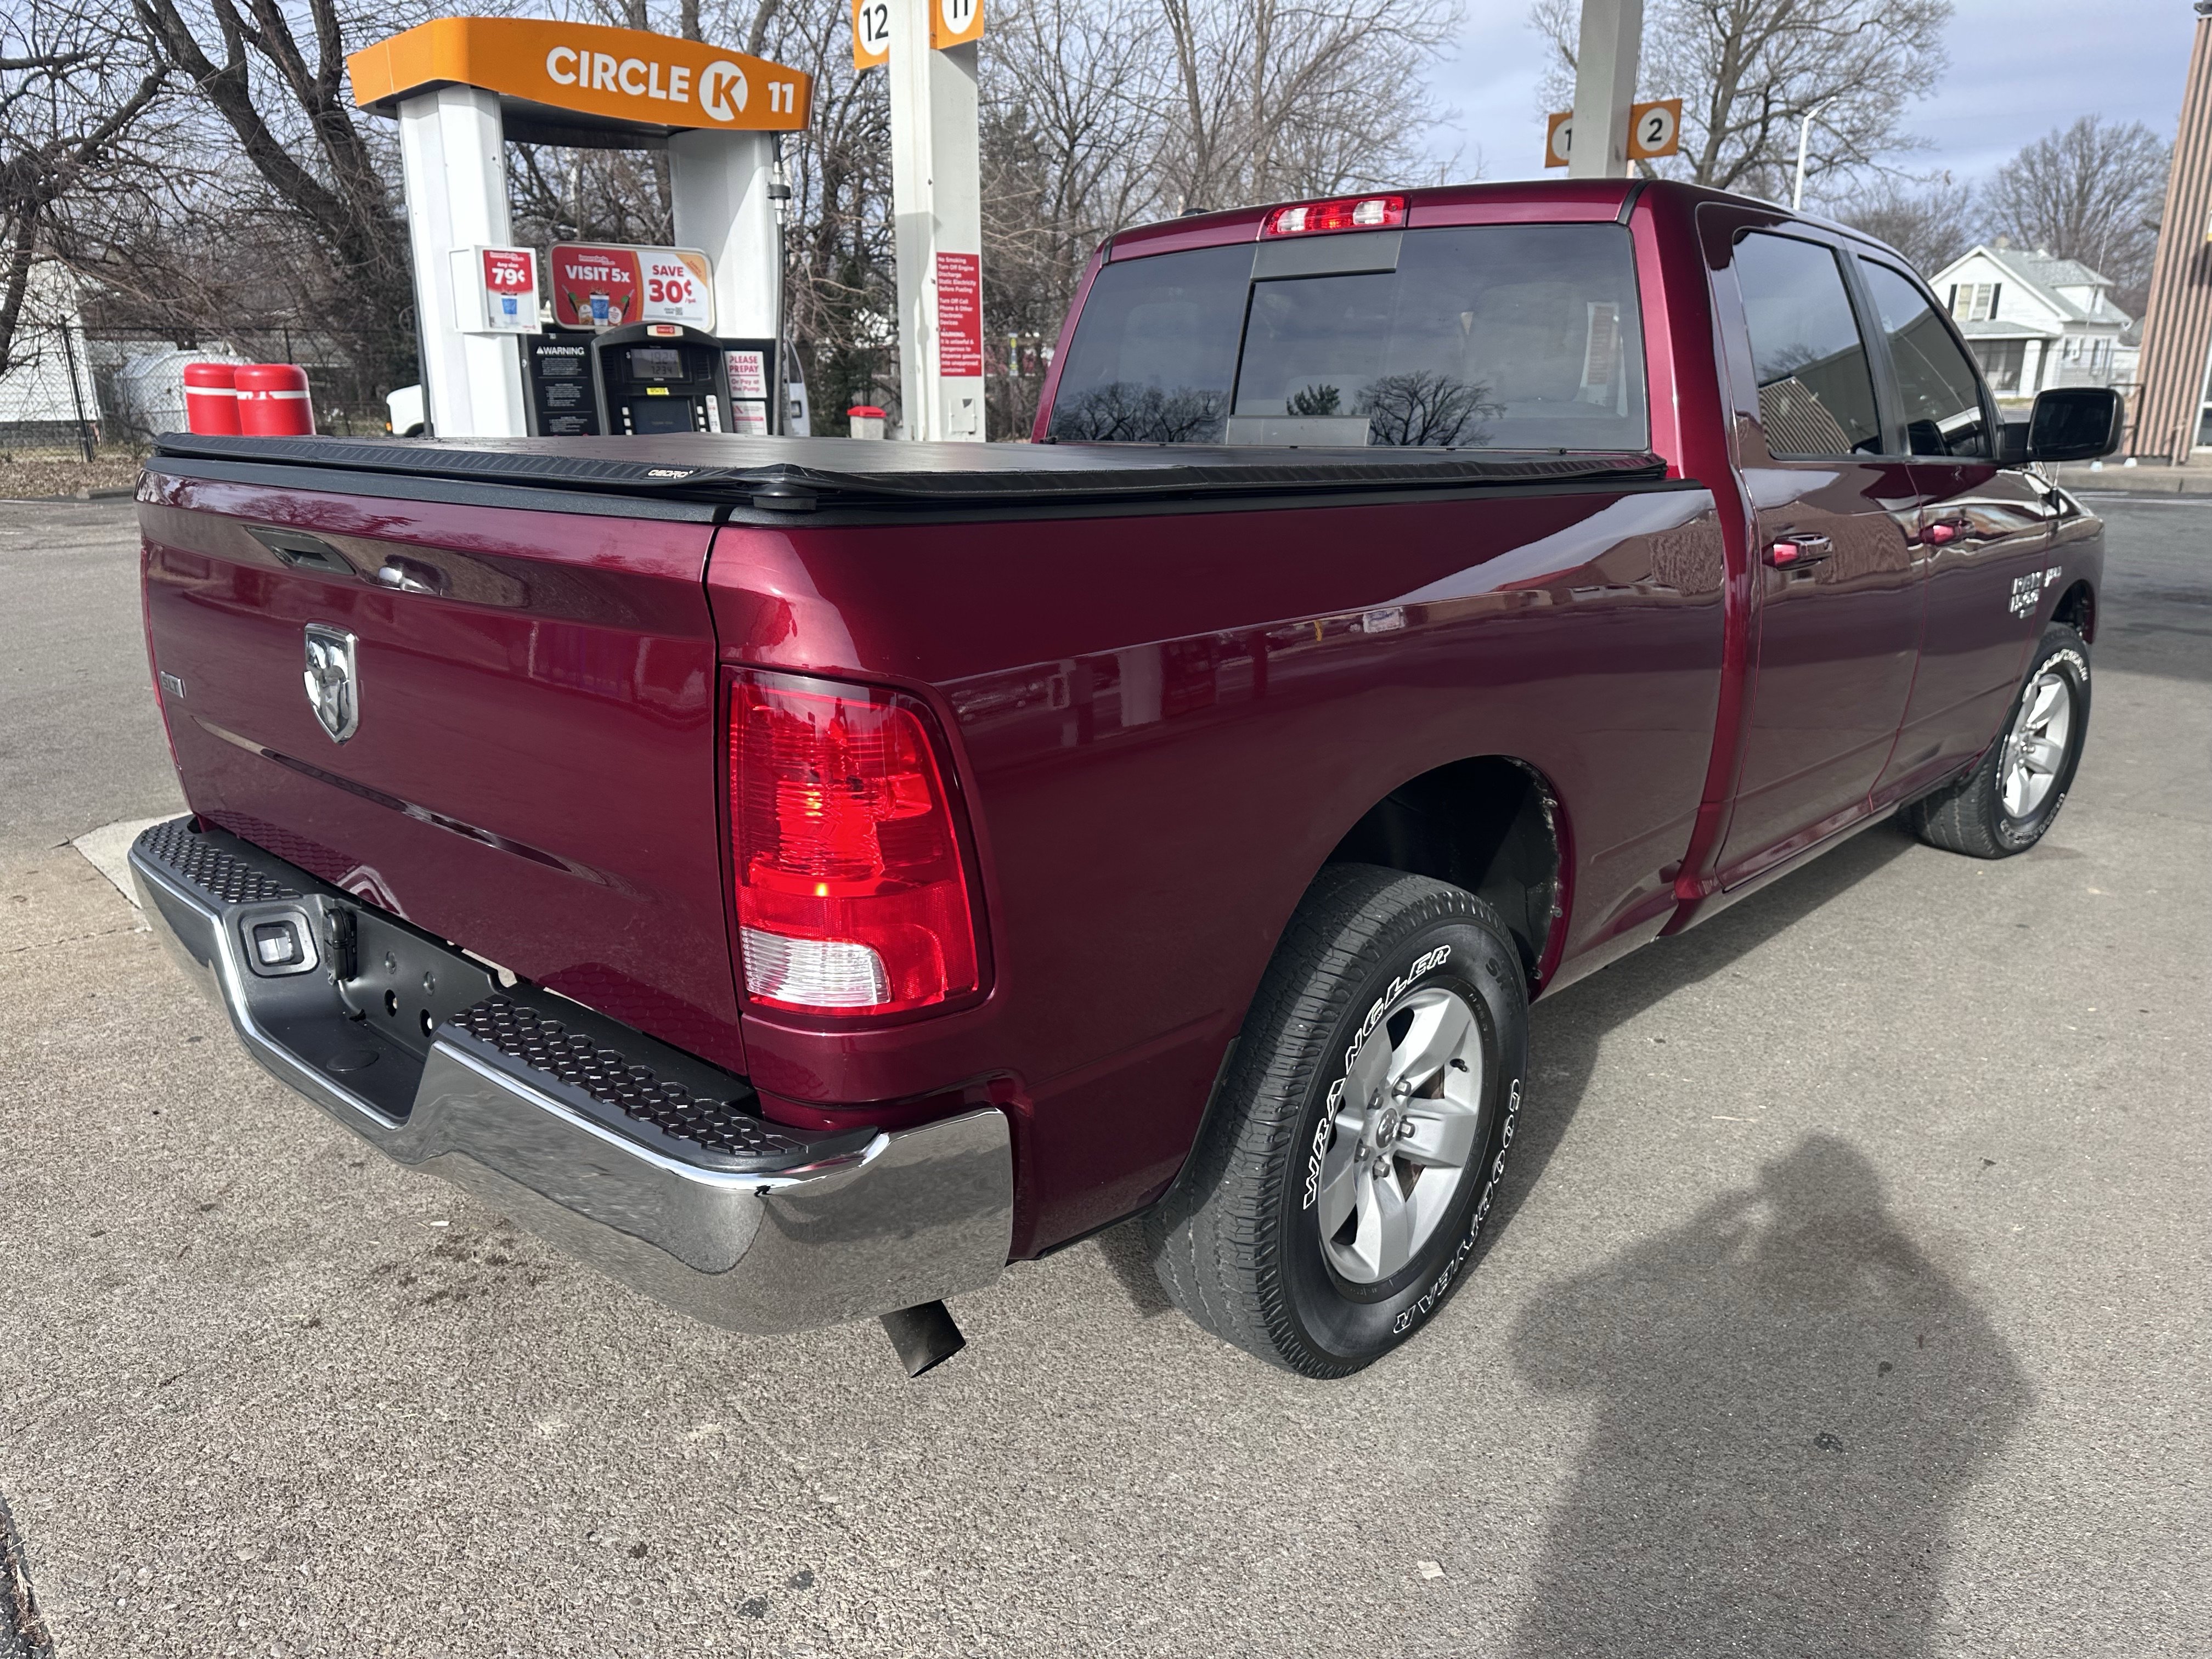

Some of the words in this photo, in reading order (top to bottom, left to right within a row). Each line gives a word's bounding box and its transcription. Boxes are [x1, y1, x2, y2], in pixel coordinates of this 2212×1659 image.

[863, 3, 889, 42] 12
[546, 46, 691, 103] CIRCLE
[708, 69, 746, 120] K
[768, 81, 794, 114] 11
[1646, 117, 1662, 143] 2
[492, 267, 526, 285] 79¢
[565, 264, 609, 281] VISIT
[611, 268, 631, 283] 5x
[652, 264, 684, 276] SAVE
[648, 278, 692, 303] 30¢
[543, 346, 584, 356] WARNING
[729, 356, 758, 364] PLEASE
[162, 676, 178, 692] SLT
[1303, 944, 1452, 1211] WRANGLER
[1392, 1078, 1521, 1335] GOODYEAR
